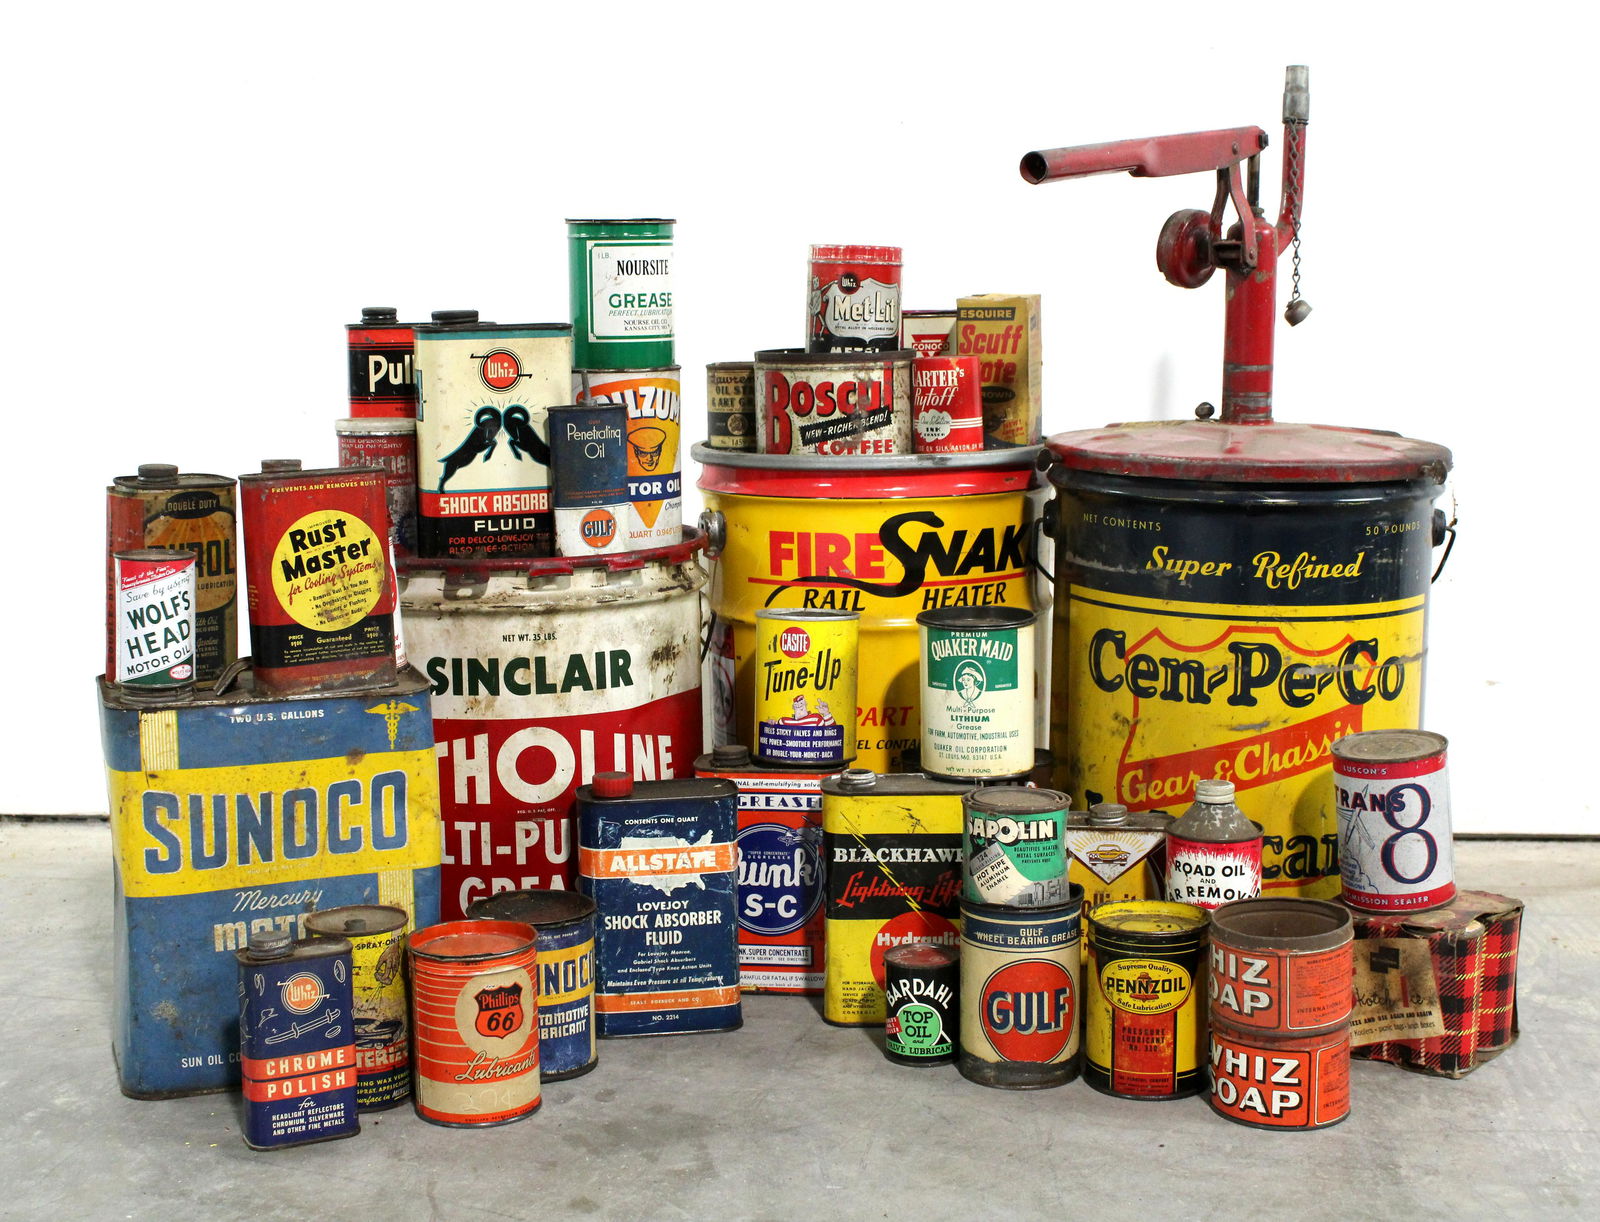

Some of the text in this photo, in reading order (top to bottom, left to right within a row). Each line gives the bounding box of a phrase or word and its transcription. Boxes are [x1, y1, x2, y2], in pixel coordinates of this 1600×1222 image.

[617, 259, 669, 276] NOURSITE
[608, 292, 673, 308] GREASE
[960, 309, 1012, 319] ESQUIRE
[912, 343, 949, 351] CONOCO
[959, 323, 1024, 355] Scuff
[486, 356, 518, 379] Whiz
[566, 423, 622, 447] Penetrating
[584, 442, 605, 460] Oil
[326, 481, 358, 489] REMOVES
[666, 480, 680, 493] OIL
[167, 499, 218, 512] DOUBLE DUTY
[439, 496, 488, 515] SHOCK
[474, 517, 536, 532] FLUID
[582, 519, 615, 538] GULF
[1083, 512, 1162, 532] NET CONTENTS
[1365, 520, 1421, 536] 50 POUNDS
[288, 518, 348, 554] Rust
[280, 537, 372, 582] Master
[1146, 545, 1365, 590] Super Refined
[126, 591, 150, 604] Save
[152, 583, 165, 597] by
[167, 575, 191, 592] using
[288, 584, 303, 607] for
[304, 572, 337, 592] Cooling
[338, 561, 377, 582] Systems
[802, 582, 1007, 611] RAIL HEATER
[126, 590, 191, 631] WOLF'S
[126, 618, 191, 660] HEAD
[316, 633, 353, 644] Guaranteed
[502, 634, 515, 643] NET
[518, 634, 532, 642] WT.
[532, 633, 542, 642] 35
[781, 632, 808, 653] CASITE
[931, 638, 1014, 662] QUAKER MAID
[126, 655, 171, 676] MOTOR
[173, 644, 191, 659] OIL
[1088, 627, 1405, 708] Cen-Pe-Co
[426, 649, 634, 696] SINCLAIR
[764, 648, 842, 701] Tune-Up
[230, 708, 325, 724] TWO U.S. GALLONS
[950, 714, 990, 723] LITHIUM
[776, 728, 823, 738] STICKY VALVES AND
[934, 729, 1008, 740] FARM, AUTOMOTIVE, INDUSTRIAL
[956, 723, 982, 731] Grease
[934, 743, 1008, 753] QUAKER OIL CORPORATION
[1343, 765, 1387, 775] LUSCON'S
[752, 780, 802, 788] self-emulsifying
[1121, 767, 1203, 806] Gear
[1213, 760, 1235, 782] &
[141, 769, 408, 875] SUNOCO
[677, 816, 699, 824] QUART
[1380, 783, 1438, 885] 8
[610, 850, 717, 873] ALLSTATE
[976, 859, 1007, 882] HOT PIPE
[1174, 860, 1246, 877] ROAD OIL
[980, 865, 1011, 888] ALUMINUM
[986, 875, 1009, 891] ENAMEL
[232, 888, 323, 913] Mercury
[636, 900, 689, 912] LOVEJOY
[744, 893, 798, 918] S-C
[1394, 895, 1429, 906] SEALER
[604, 909, 722, 931] SHOCK ABSORBER
[645, 930, 683, 946] FLUID
[976, 928, 1078, 945] WHEEL BEARING GREASE
[1019, 928, 1044, 937] GULF
[748, 948, 809, 958] SUPER CONCENTRATE
[1117, 963, 1173, 975] Supreme Quality
[290, 983, 317, 1002] Whiz
[886, 978, 954, 1010] BARDAHL
[1106, 976, 1186, 995] PENNZOIL
[481, 991, 519, 1007] Phillips
[1116, 997, 1172, 1012] Safe Lubrication
[903, 1010, 934, 1024] TOP
[986, 987, 1070, 1035] GULF
[486, 1011, 516, 1032] 66
[904, 1025, 932, 1038] OIL
[1121, 1034, 1166, 1045] LUBRICANT
[181, 1055, 224, 1068] SUN OIL
[265, 1049, 346, 1076] CHROME
[267, 1072, 347, 1098] POLISH
[271, 1103, 346, 1121] HEADLIGHT REFLECTORS
[299, 1096, 317, 1110] for
[272, 1111, 346, 1129] CHROMIUM, SILVERWARE
[272, 1118, 346, 1137] AND OTHER FINE METALS
